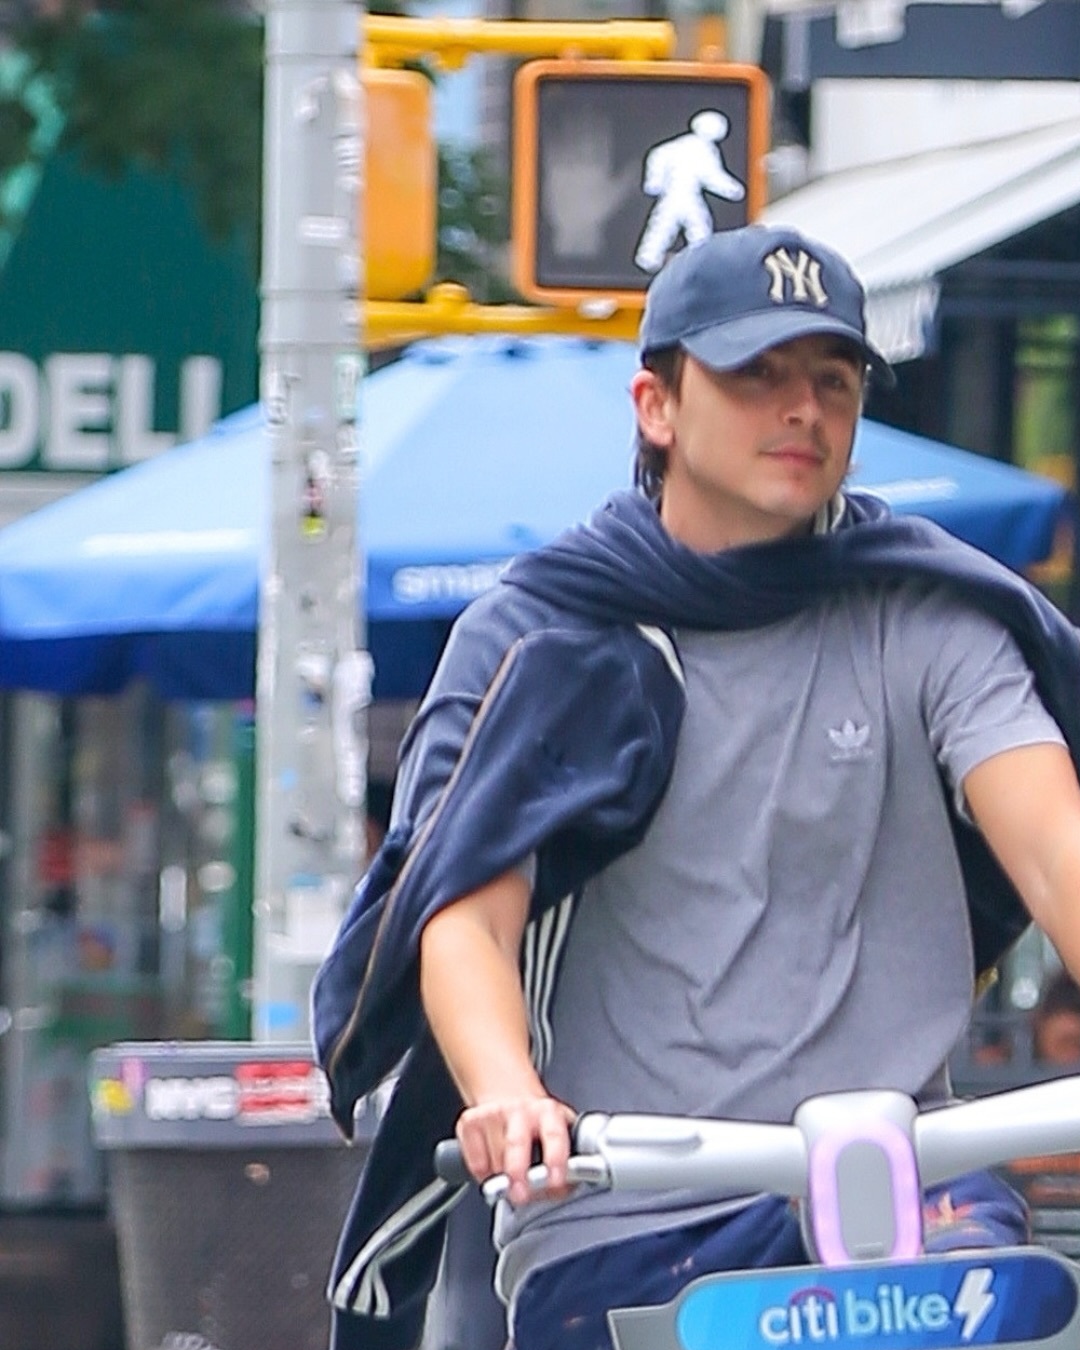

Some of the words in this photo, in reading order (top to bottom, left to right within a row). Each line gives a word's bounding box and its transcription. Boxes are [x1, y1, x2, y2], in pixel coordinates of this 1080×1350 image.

[764, 247, 828, 307] NY
[759, 1287, 838, 1344] citi
[844, 1284, 951, 1336] bike
